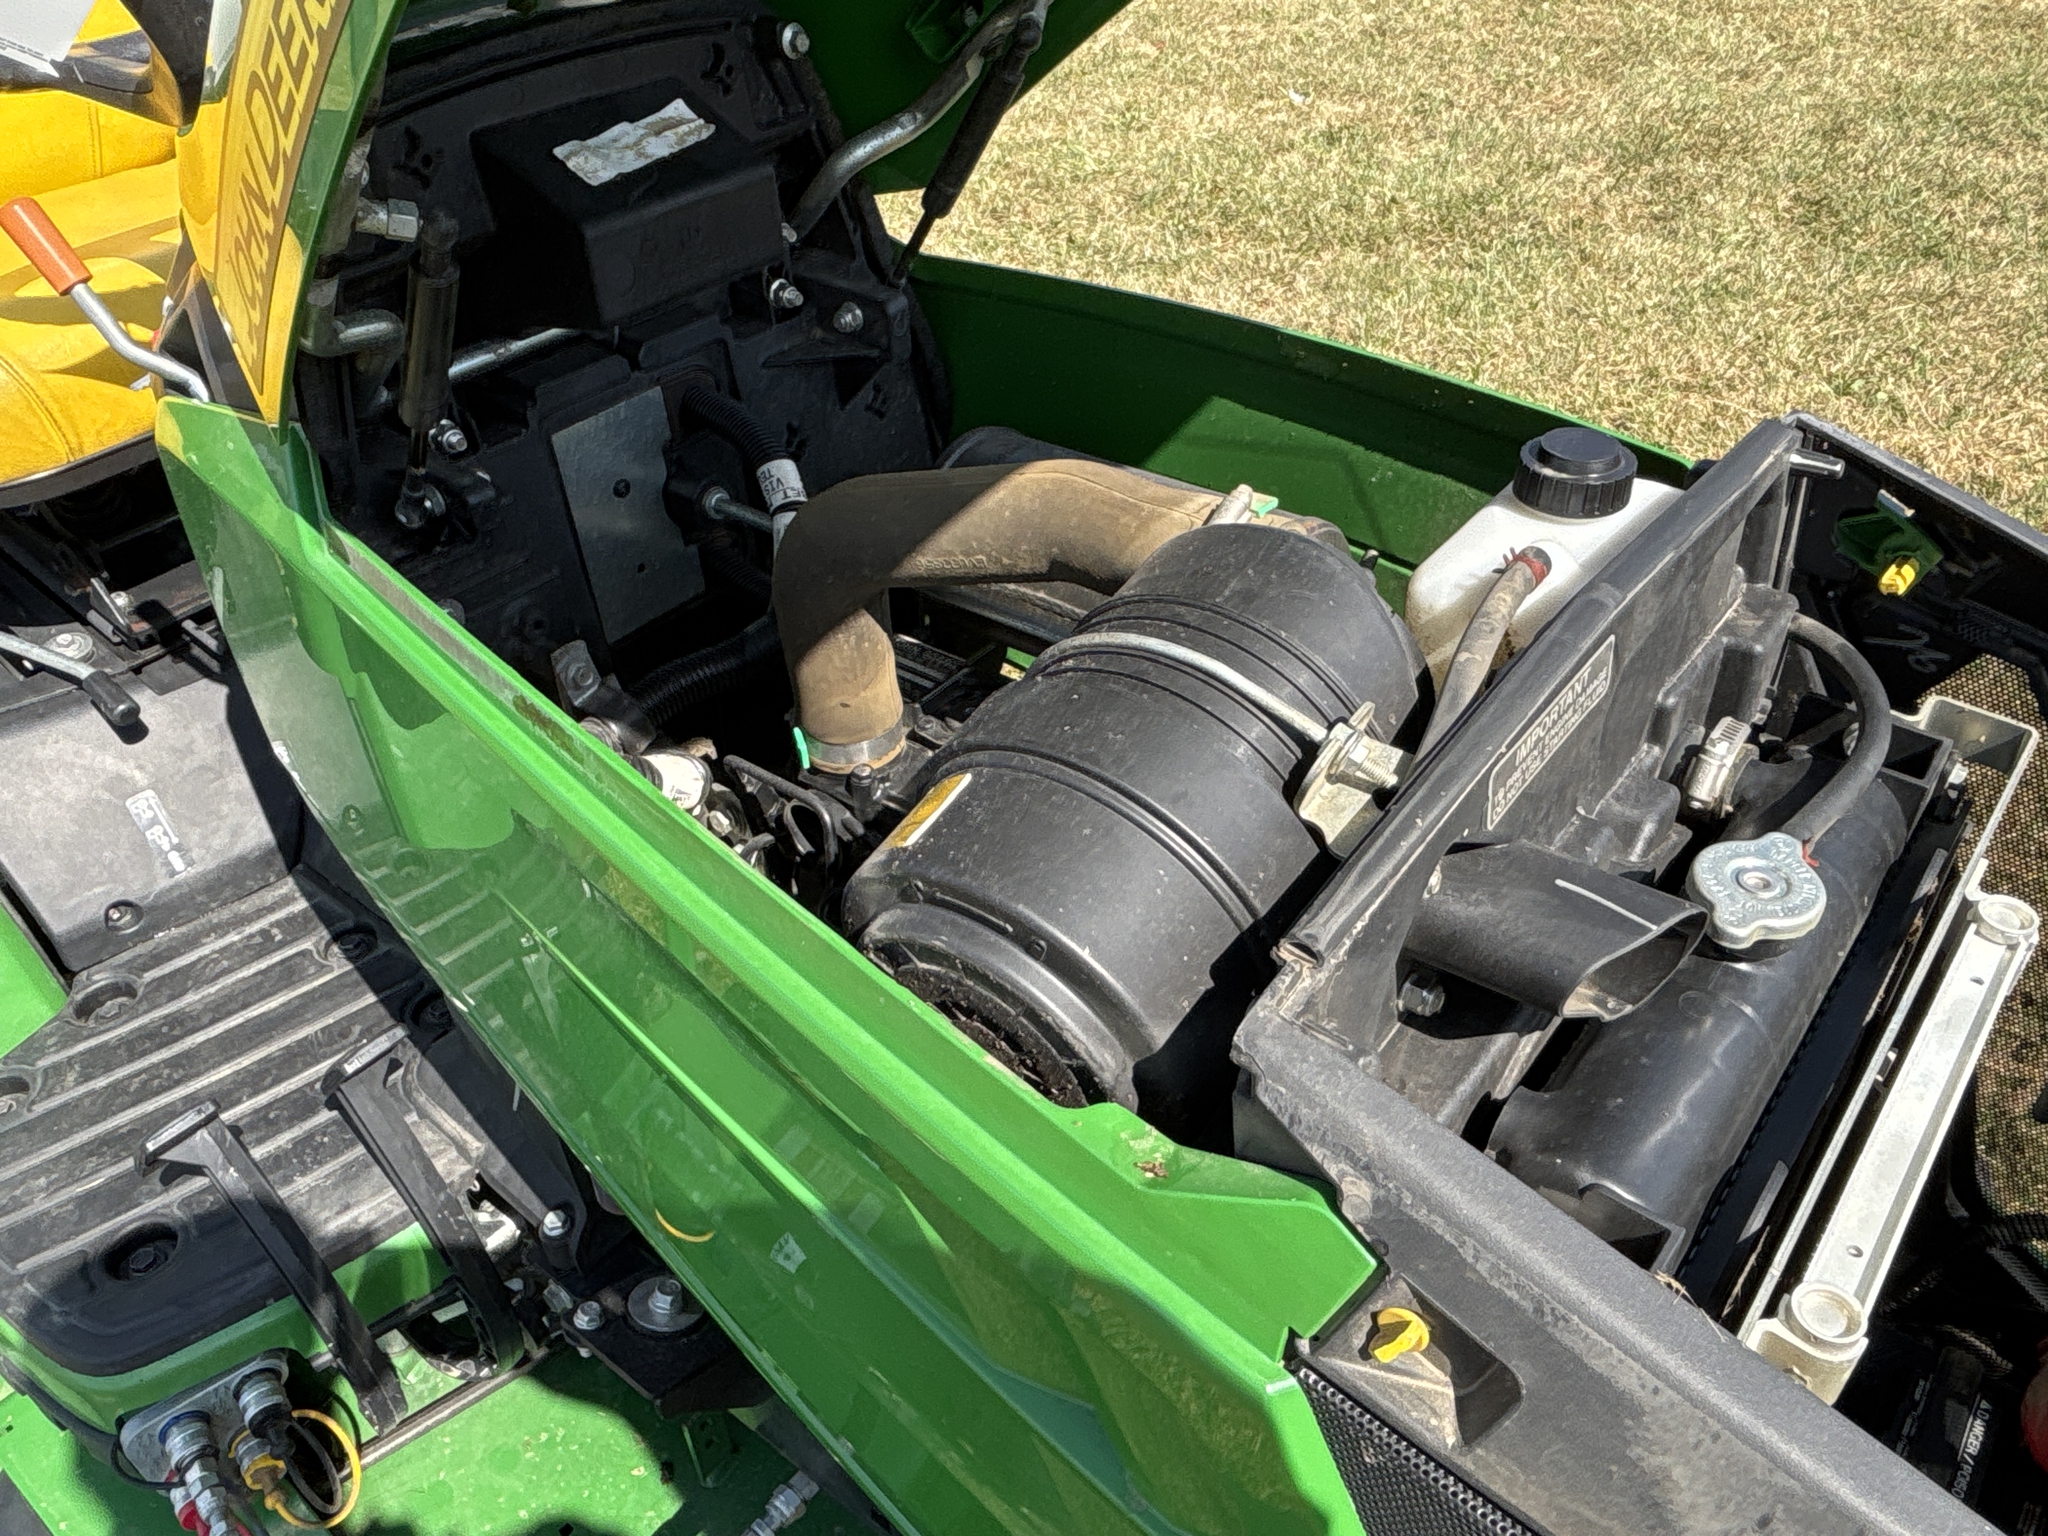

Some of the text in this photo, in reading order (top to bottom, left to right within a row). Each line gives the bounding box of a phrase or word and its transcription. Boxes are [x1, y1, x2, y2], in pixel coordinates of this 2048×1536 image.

[228, 143, 271, 346] JOHN
[1493, 680, 1607, 821] DO NOT USE STARTING FLUID
[1494, 666, 1608, 807] TO PREVENT ENGINE DAMAGE
[1515, 666, 1592, 767] IMPORTANT
[1951, 1462, 1973, 1499] POISO
[1964, 1409, 1990, 1457] DANGER
